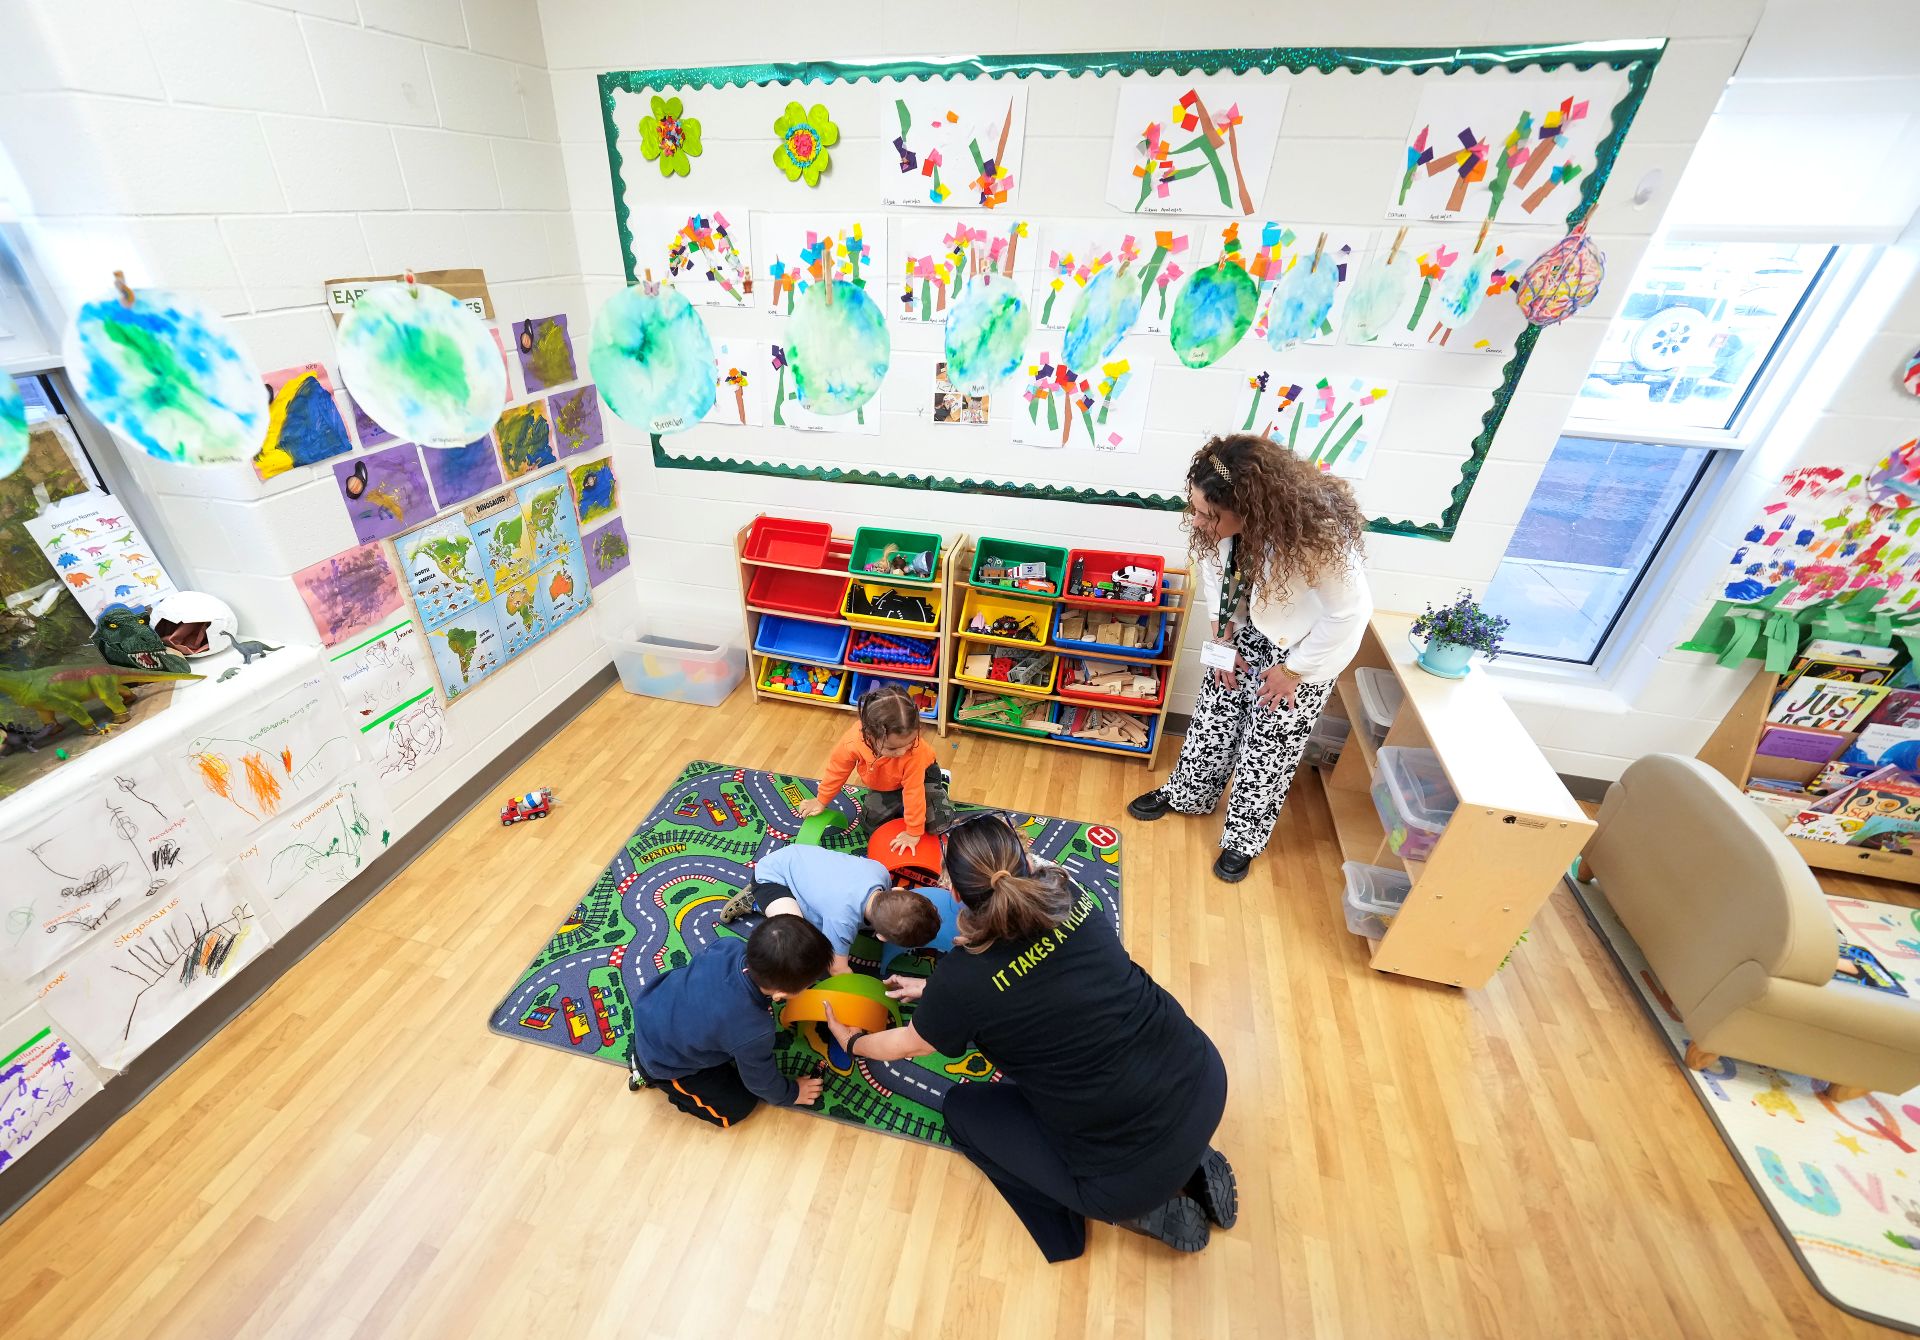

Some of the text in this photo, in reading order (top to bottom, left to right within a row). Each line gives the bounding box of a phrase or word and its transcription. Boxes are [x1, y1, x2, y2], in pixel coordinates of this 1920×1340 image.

[476, 495, 506, 513] DINOSAURS
[1786, 682, 1880, 721] JUST
[639, 842, 687, 864] RENAULT
[991, 969, 1011, 992] IT
[1008, 936, 1056, 977] TAKES
[1053, 928, 1068, 944] A
